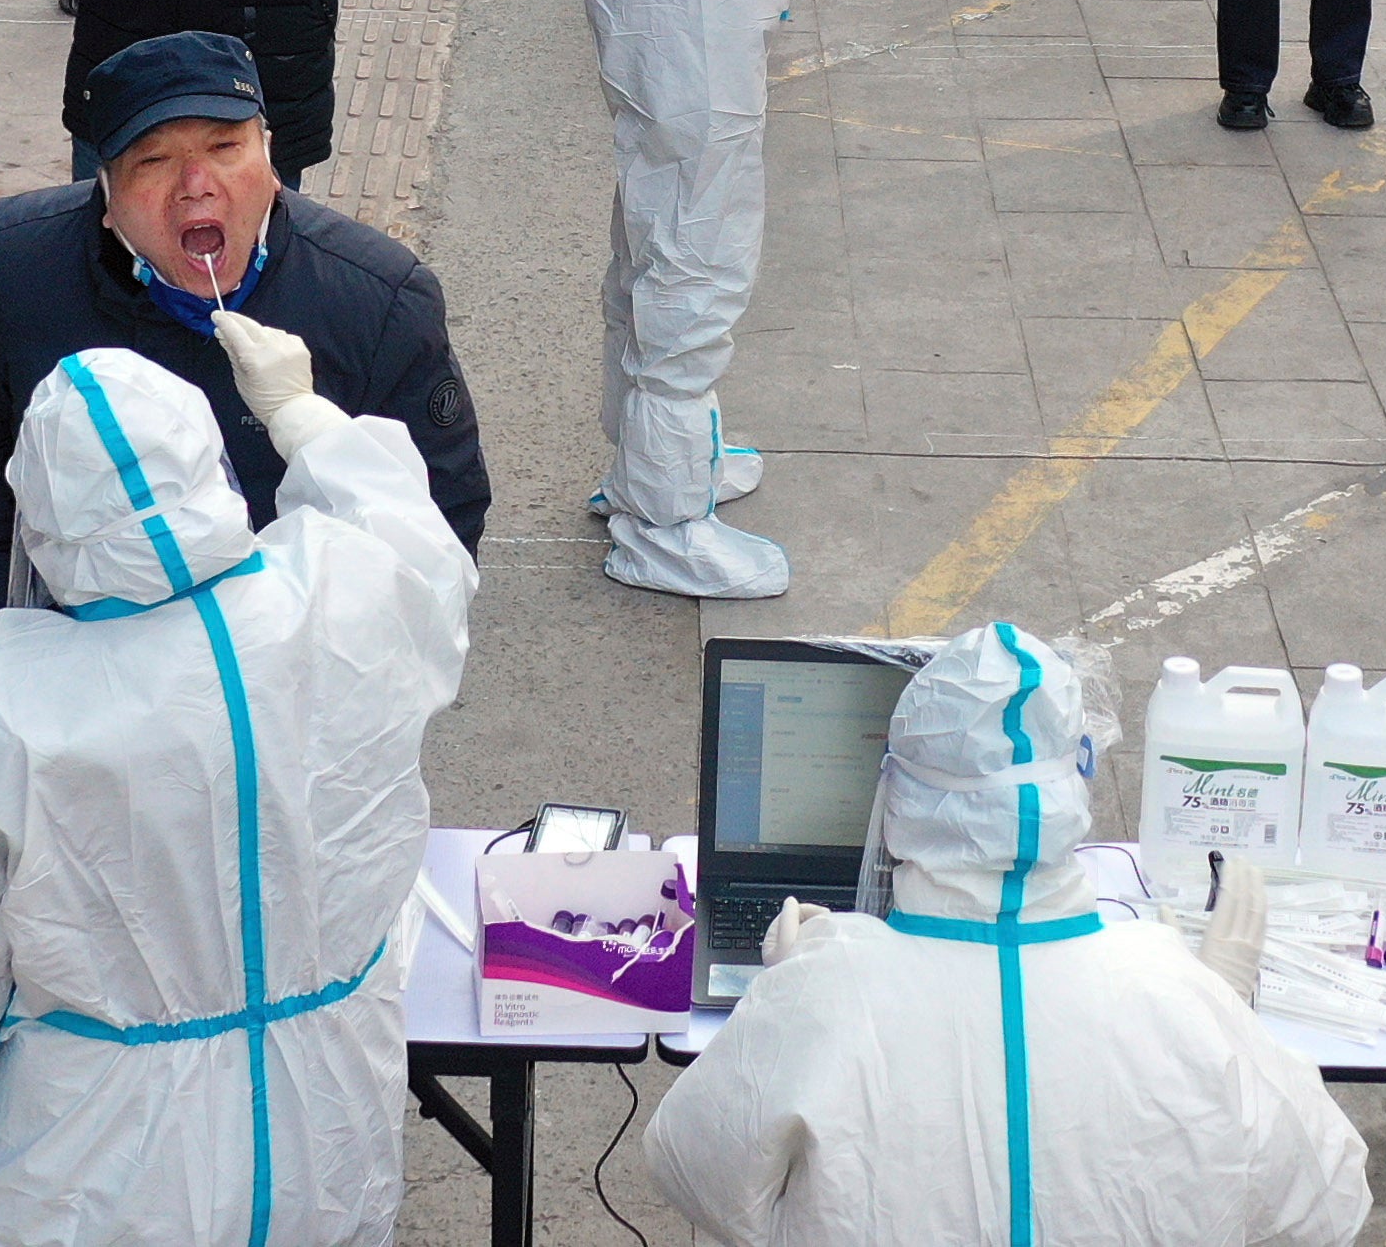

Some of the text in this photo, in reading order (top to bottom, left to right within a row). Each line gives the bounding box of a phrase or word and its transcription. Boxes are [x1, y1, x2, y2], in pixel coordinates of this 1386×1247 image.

[1182, 773, 1235, 798] Mint
[494, 1003, 526, 1011] In Vitro
[494, 1010, 539, 1020] Diagnostic
[493, 1018, 534, 1027] Reagents
